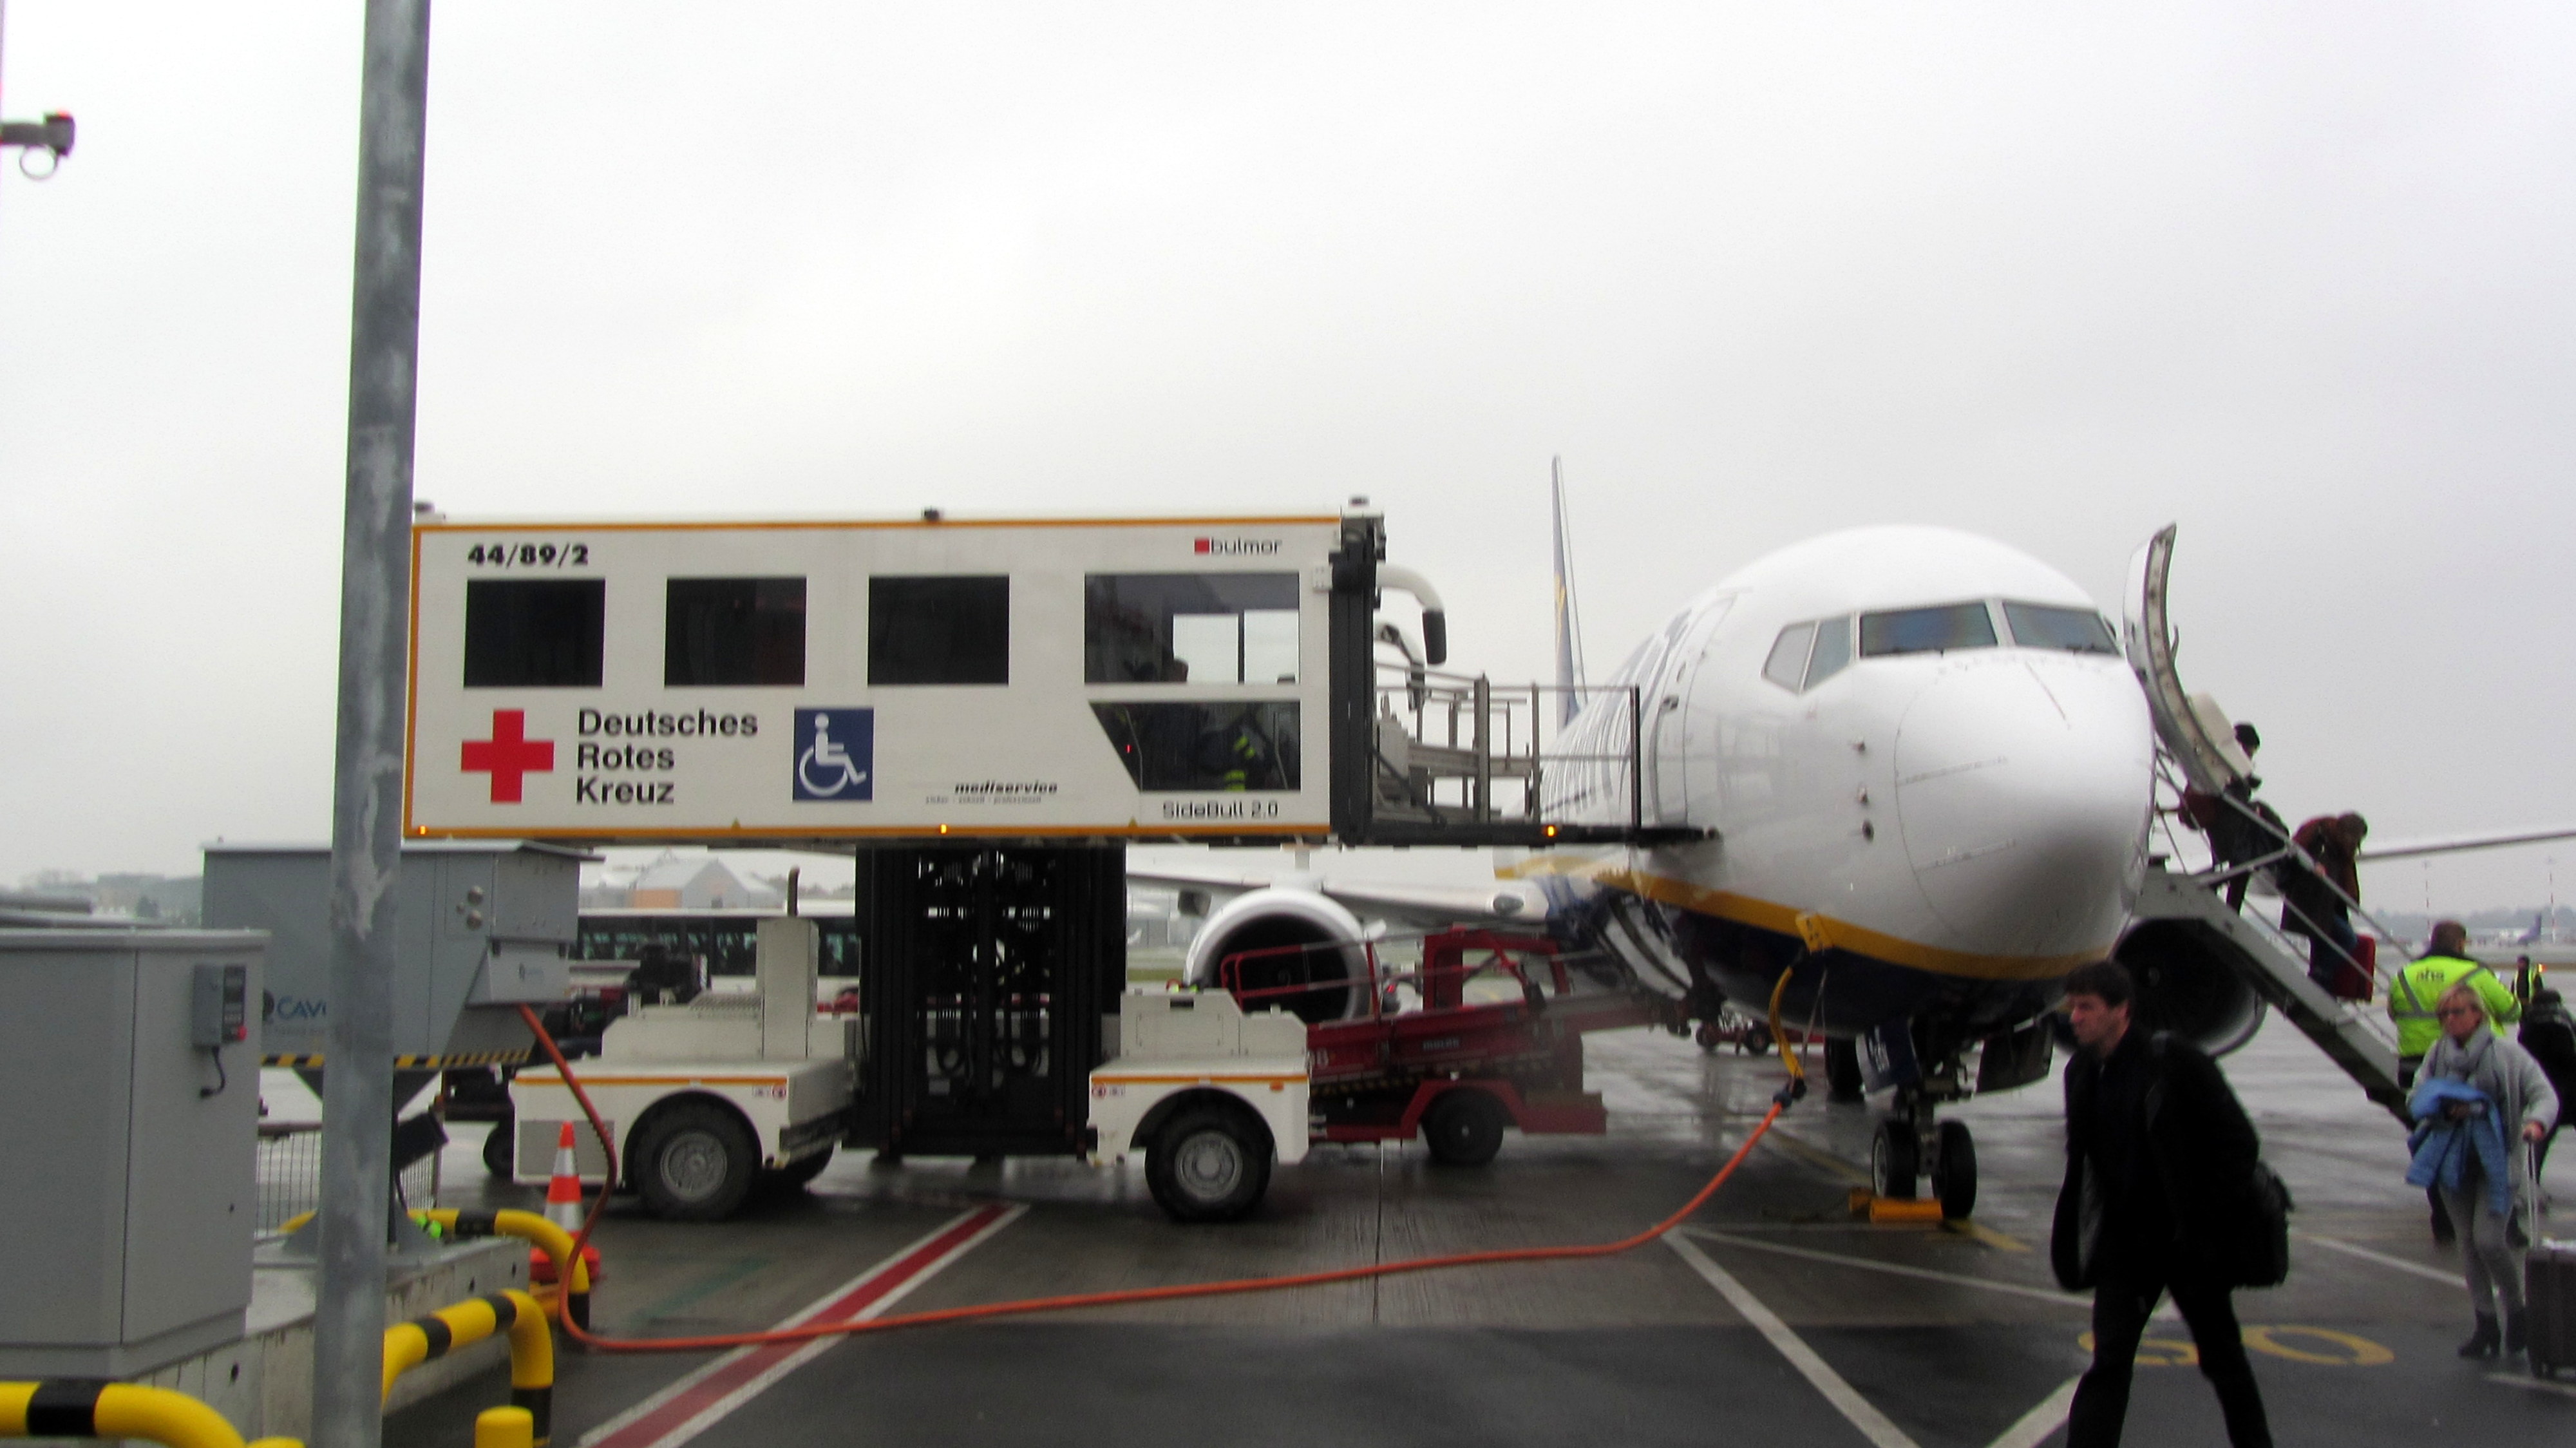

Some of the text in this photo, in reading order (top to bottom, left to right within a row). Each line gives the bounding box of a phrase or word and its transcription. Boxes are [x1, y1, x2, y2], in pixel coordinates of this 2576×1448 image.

[468, 543, 589, 567] 44/89/2
[1211, 537, 1282, 555] bulmor
[578, 709, 758, 737] Deutsches
[577, 743, 675, 770] Rotes
[576, 776, 674, 804] Kreuz
[1162, 800, 1279, 819] SideBull 2.0
